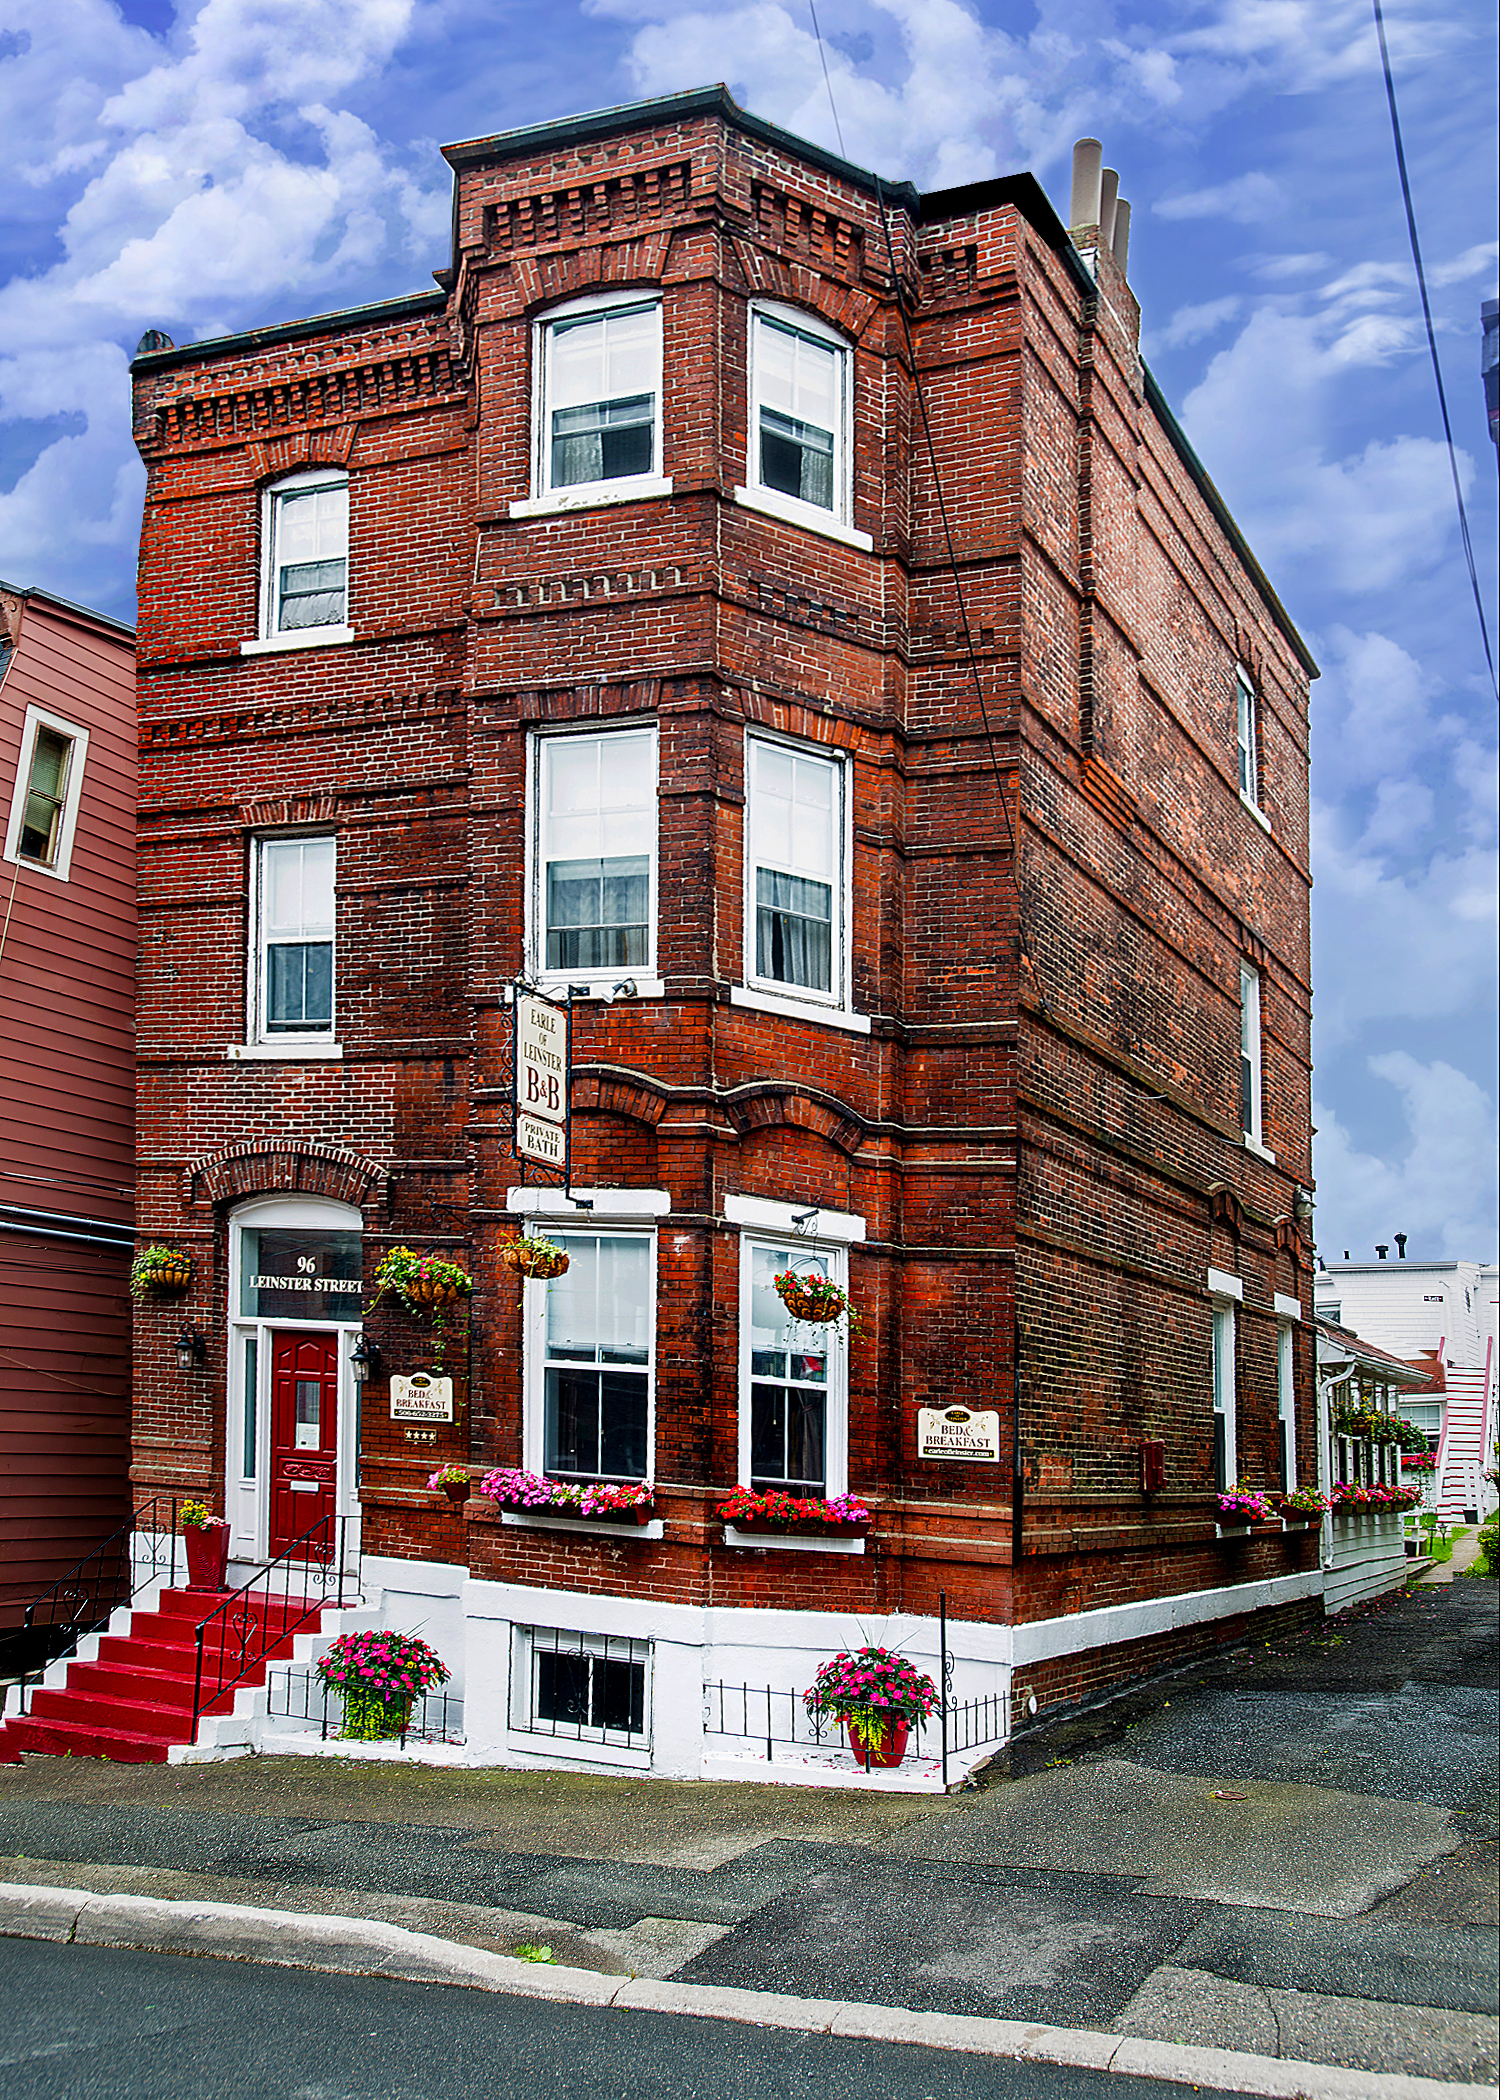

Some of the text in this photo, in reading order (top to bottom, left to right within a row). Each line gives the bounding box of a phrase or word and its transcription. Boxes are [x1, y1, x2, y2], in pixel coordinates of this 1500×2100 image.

[530, 1008, 557, 1035] EARLE
[538, 1032, 548, 1047] OF
[523, 1041, 562, 1073] LEINSTER
[526, 1065, 560, 1112] B&B
[524, 1122, 561, 1144] PRIVATE
[526, 1134, 559, 1158] BATH
[296, 1255, 316, 1274] 96
[248, 1274, 364, 1294] LEINSTER STREET
[395, 1398, 446, 1411] BREAKFAST
[925, 1435, 991, 1448] BREAKFAST
